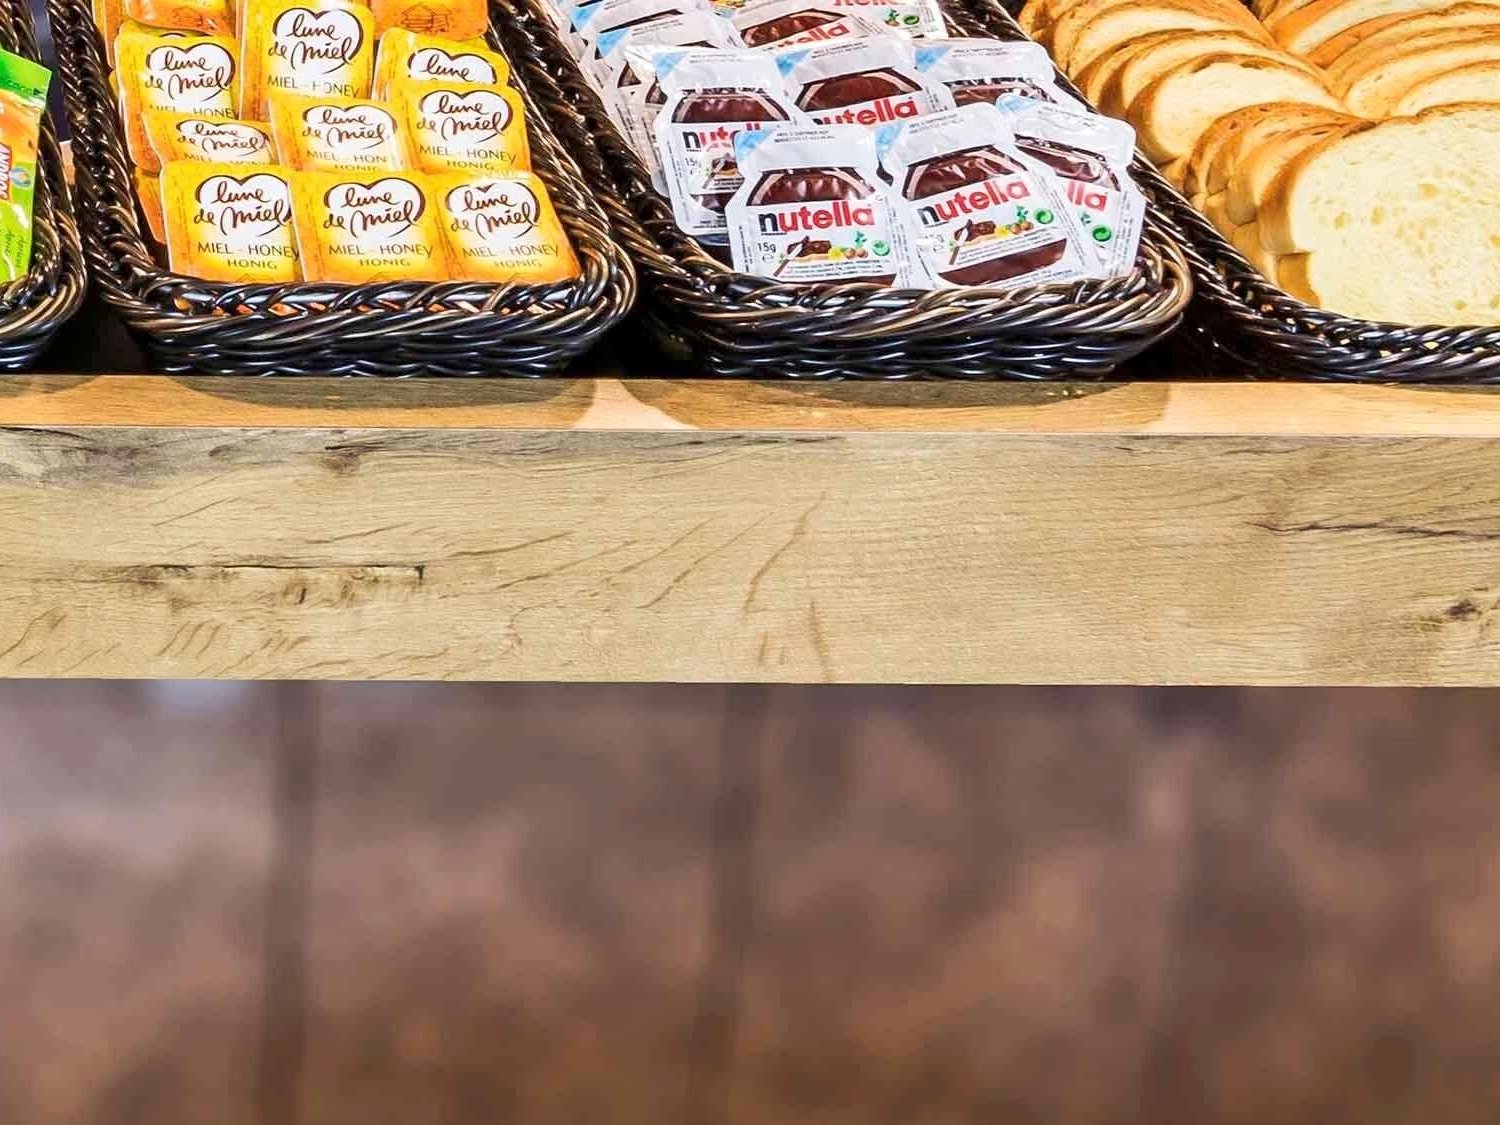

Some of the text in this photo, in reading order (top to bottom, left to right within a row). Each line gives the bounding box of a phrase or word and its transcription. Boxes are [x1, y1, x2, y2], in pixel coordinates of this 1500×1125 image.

[435, 95, 489, 114] lune
[417, 114, 505, 141] de miel
[212, 181, 270, 203] lune
[341, 188, 401, 207] lune
[917, 179, 1030, 226] nutella
[194, 200, 292, 235] de miel
[324, 201, 418, 238] de miel
[759, 202, 875, 232] nutella
[198, 242, 300, 261] MIEL HONEY
[329, 244, 433, 258] MIEL HONEY
[758, 242, 776, 253] 15g
[227, 259, 277, 269] HONIG
